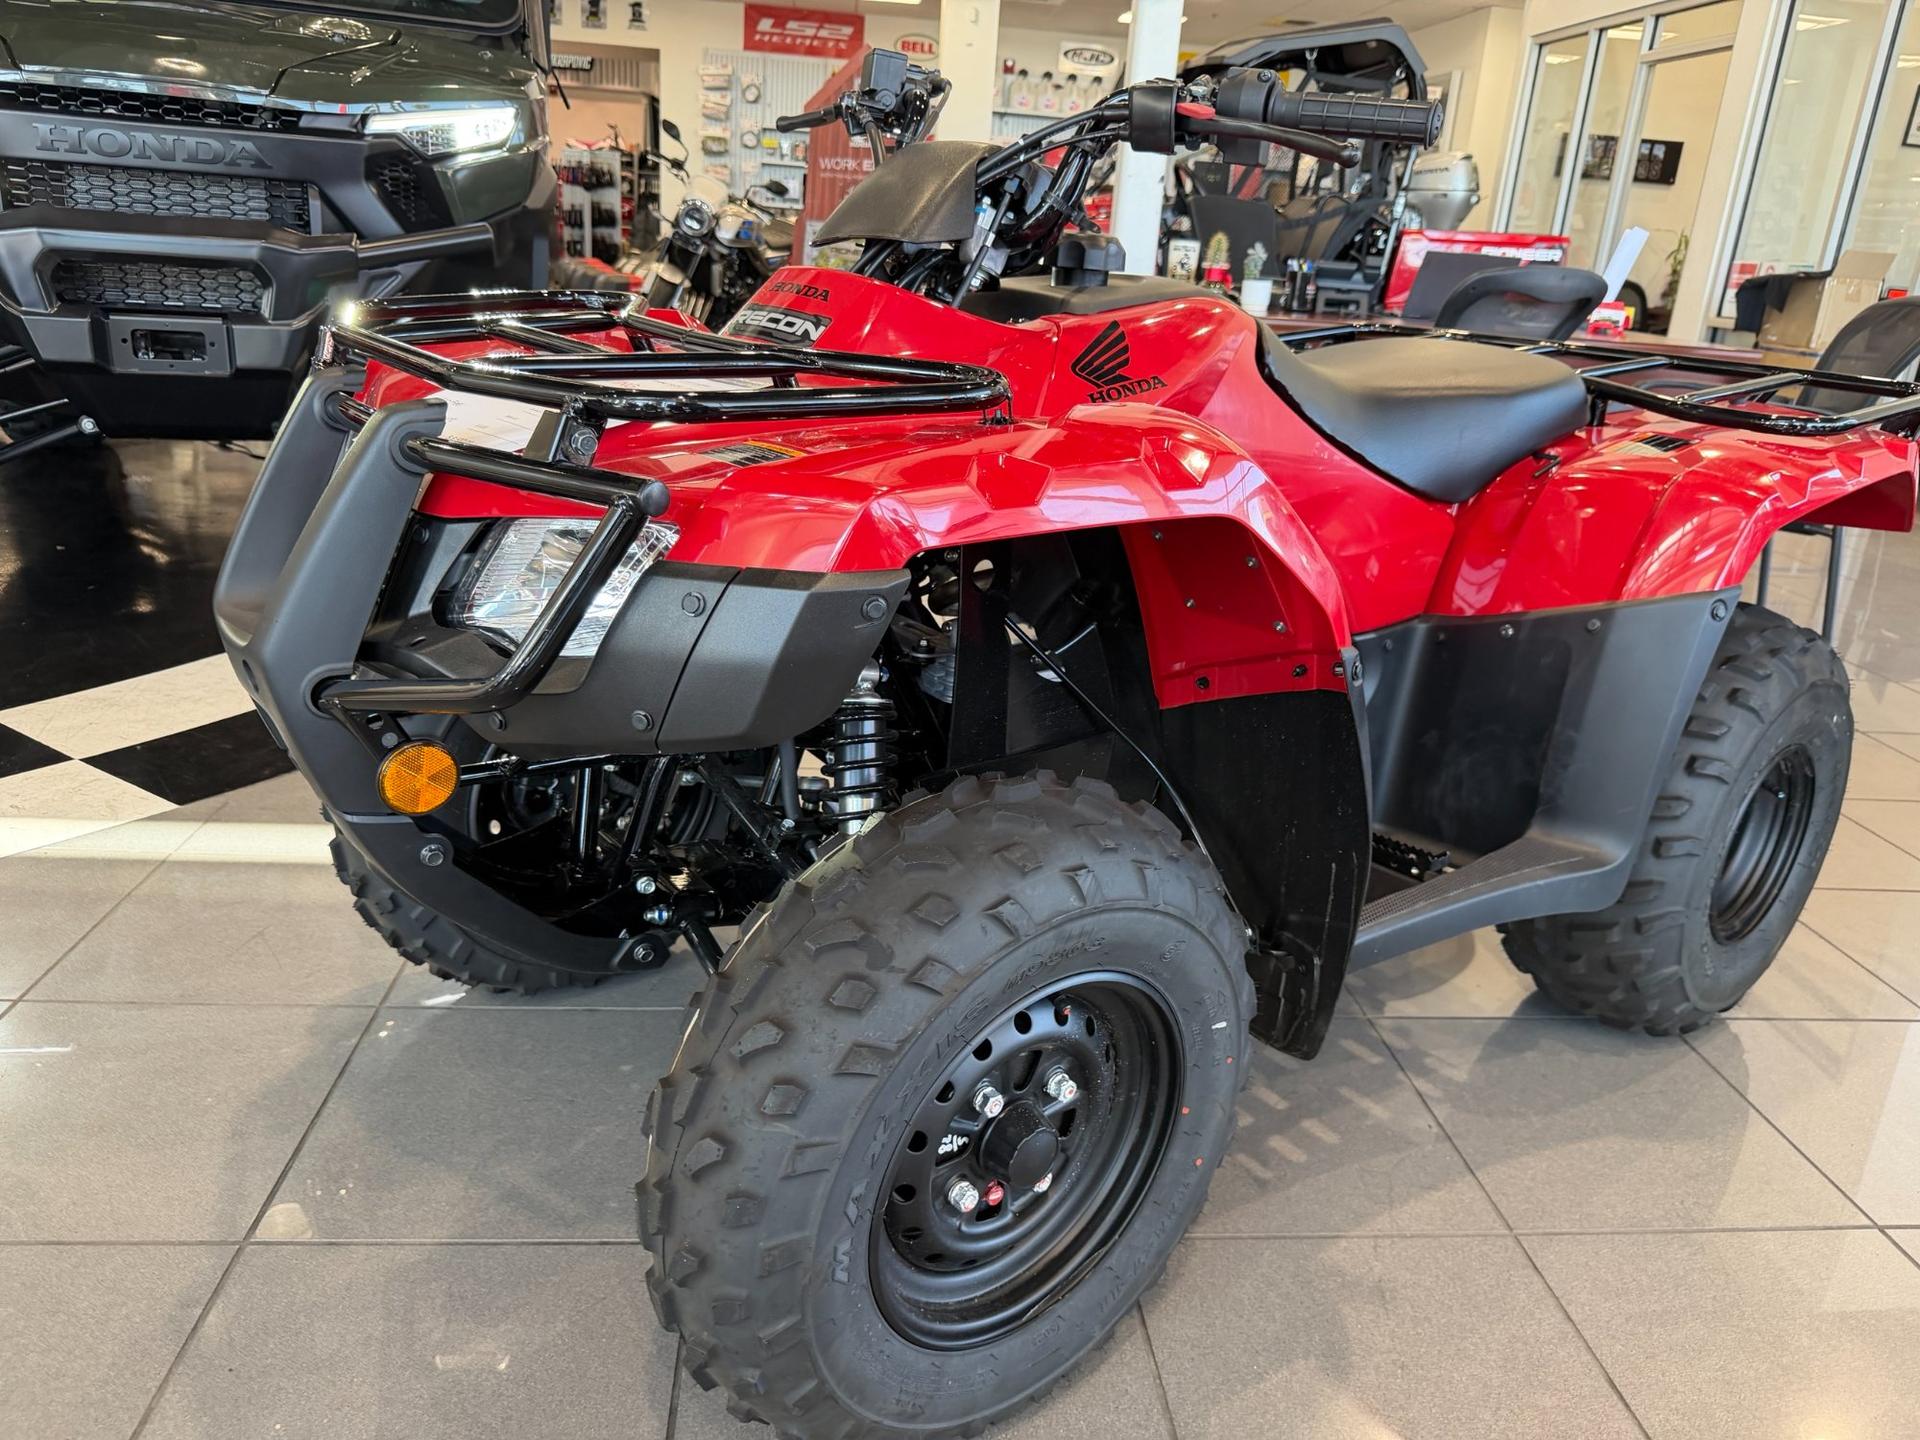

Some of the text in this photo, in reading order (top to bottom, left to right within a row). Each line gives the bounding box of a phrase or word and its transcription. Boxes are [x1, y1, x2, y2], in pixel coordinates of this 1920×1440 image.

[756, 17, 854, 40] LS2
[754, 34, 848, 49] HELMETS
[900, 40, 936, 55] BELL
[32, 122, 273, 169] HONDA
[818, 157, 861, 172] WORK
[769, 281, 831, 302] HONDA
[1087, 375, 1168, 404] HONDA
[829, 998, 992, 1284] MAXXIS
